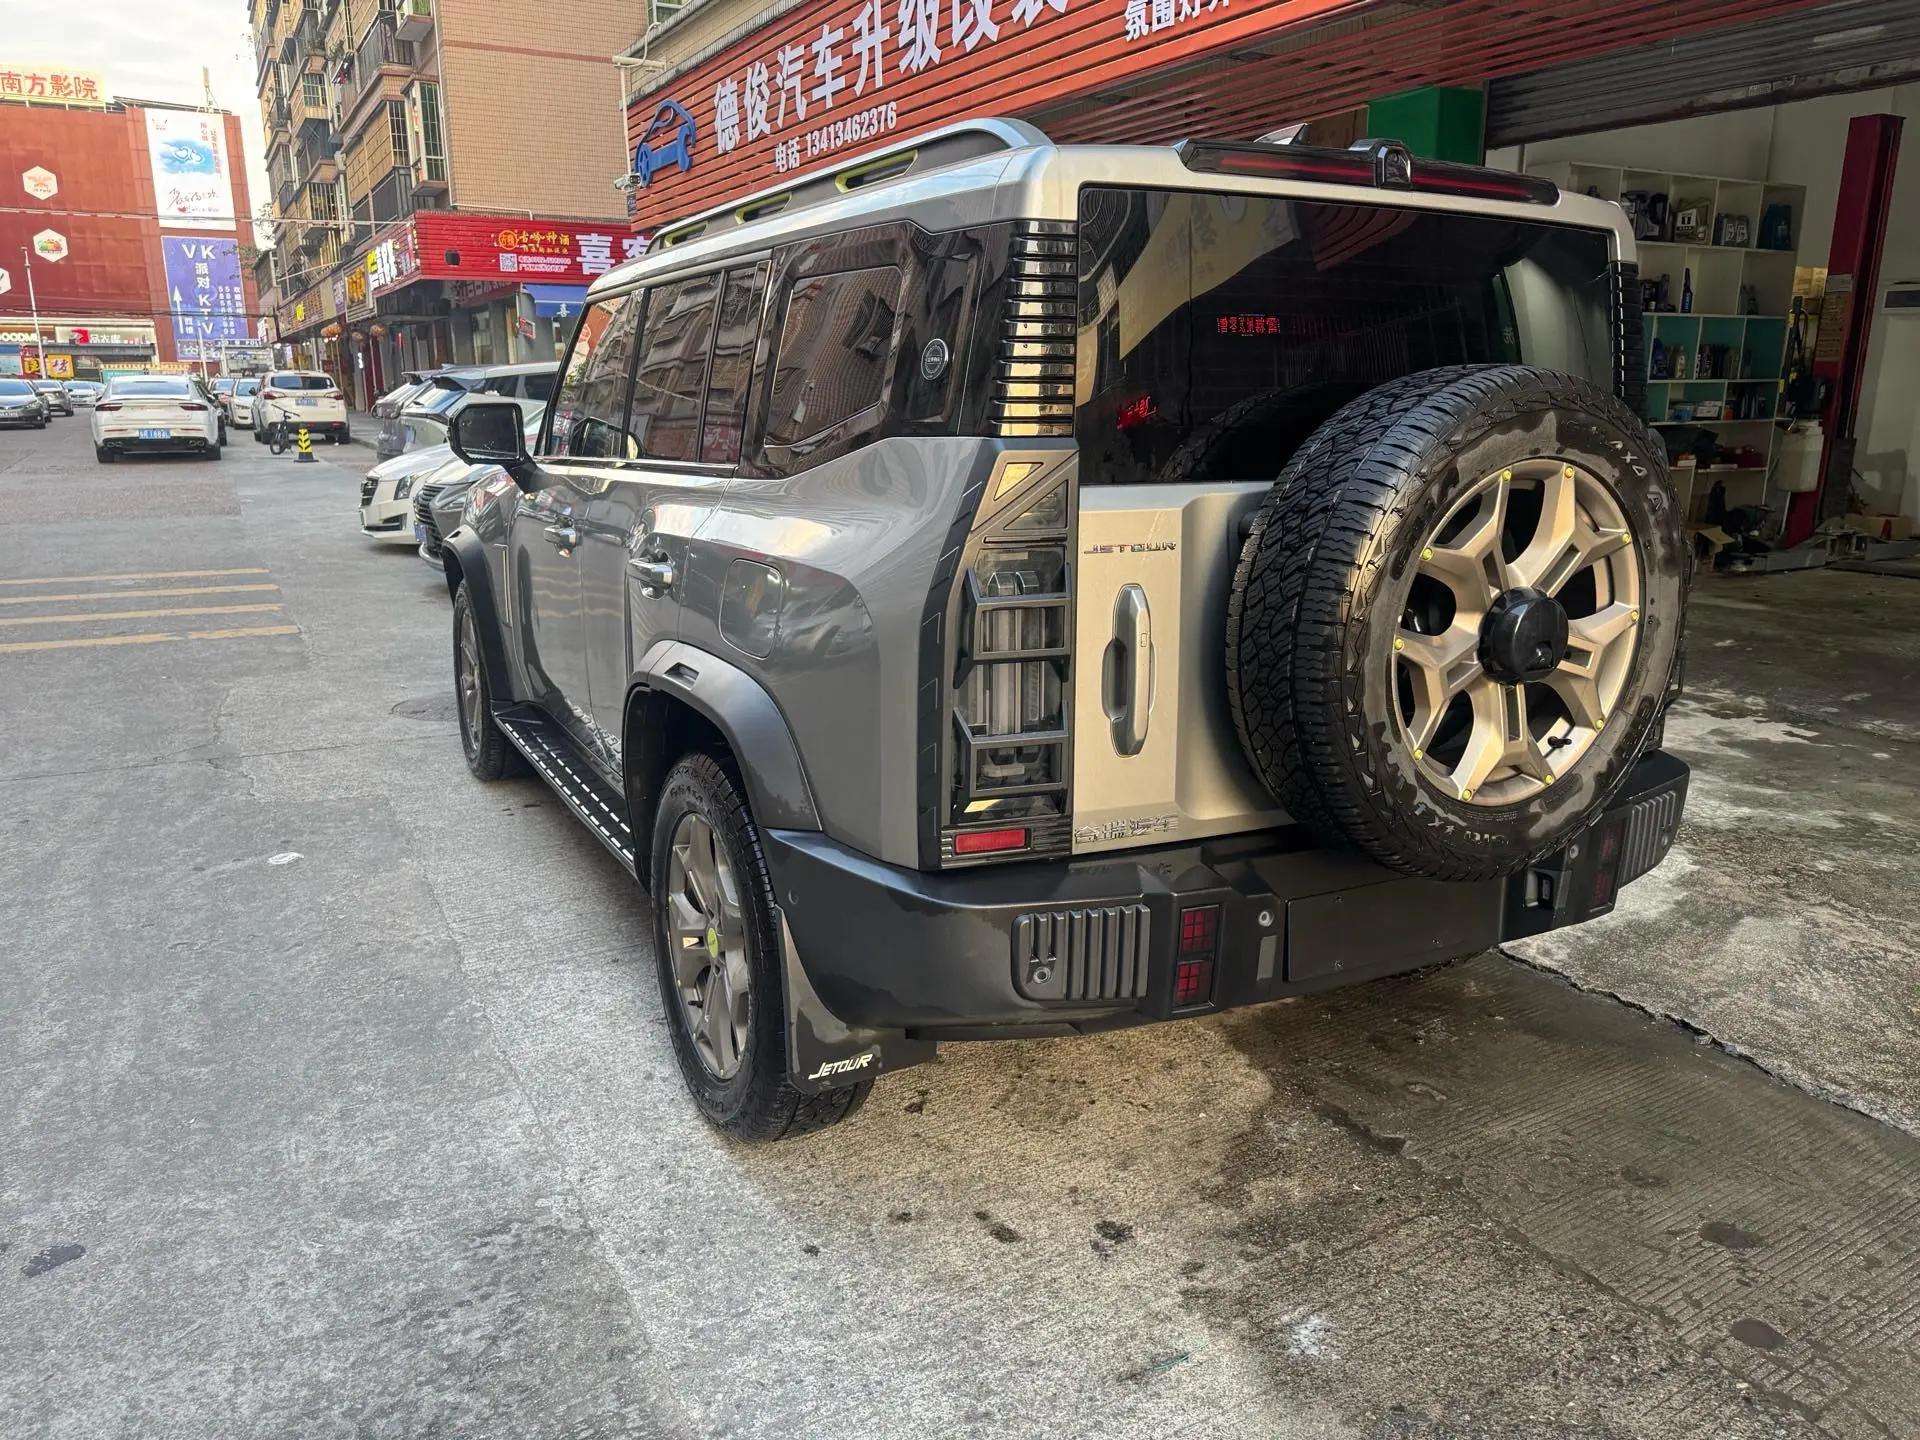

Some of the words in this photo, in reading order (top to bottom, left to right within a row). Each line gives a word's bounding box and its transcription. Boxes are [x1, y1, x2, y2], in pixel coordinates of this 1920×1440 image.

[0, 71, 98, 99] 南方影院
[714, 0, 1070, 154] 德俊汽车升级
[775, 138, 800, 173] 电话
[806, 101, 897, 158] 13413462376
[182, 244, 216, 260] VK
[1083, 541, 1177, 555] JETOUR
[807, 1053, 874, 1080] JETOUR
